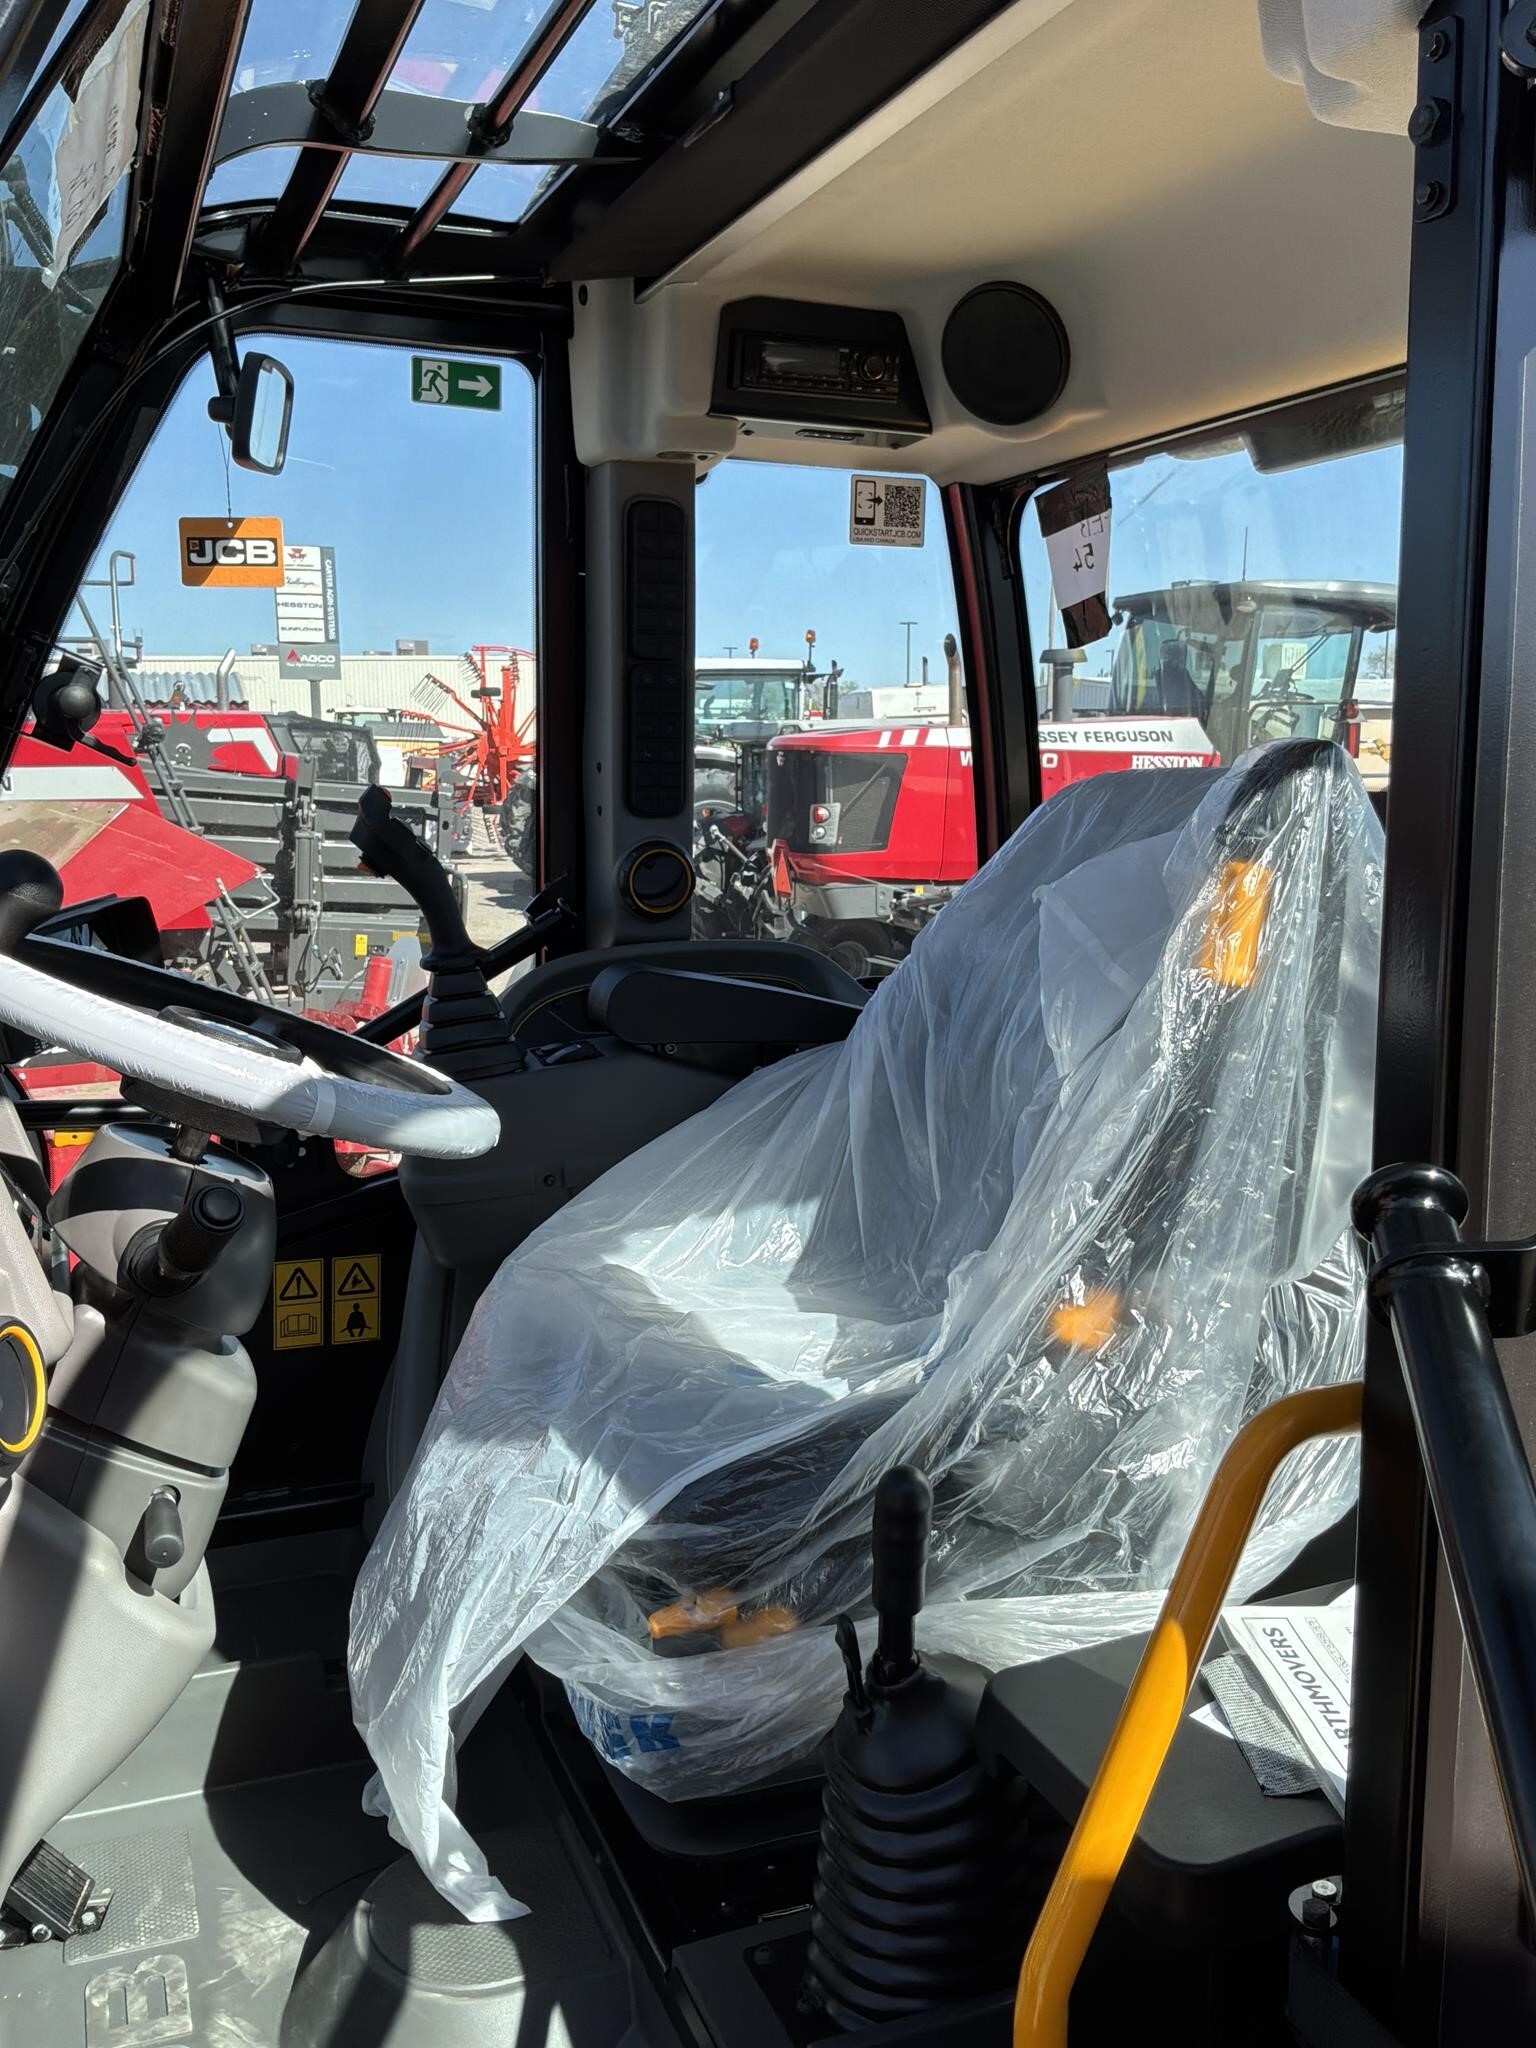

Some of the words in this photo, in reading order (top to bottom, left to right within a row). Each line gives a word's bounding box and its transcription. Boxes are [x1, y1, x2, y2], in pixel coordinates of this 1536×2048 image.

[189, 538, 276, 566] JCB
[277, 601, 323, 609] HESSTON
[300, 654, 336, 663] AGCO
[1038, 731, 1077, 744] SSEY
[1084, 730, 1174, 742] FERGUSON
[1131, 754, 1205, 769] HESSTON
[1262, 1626, 1350, 1748] RTHMOVERS
